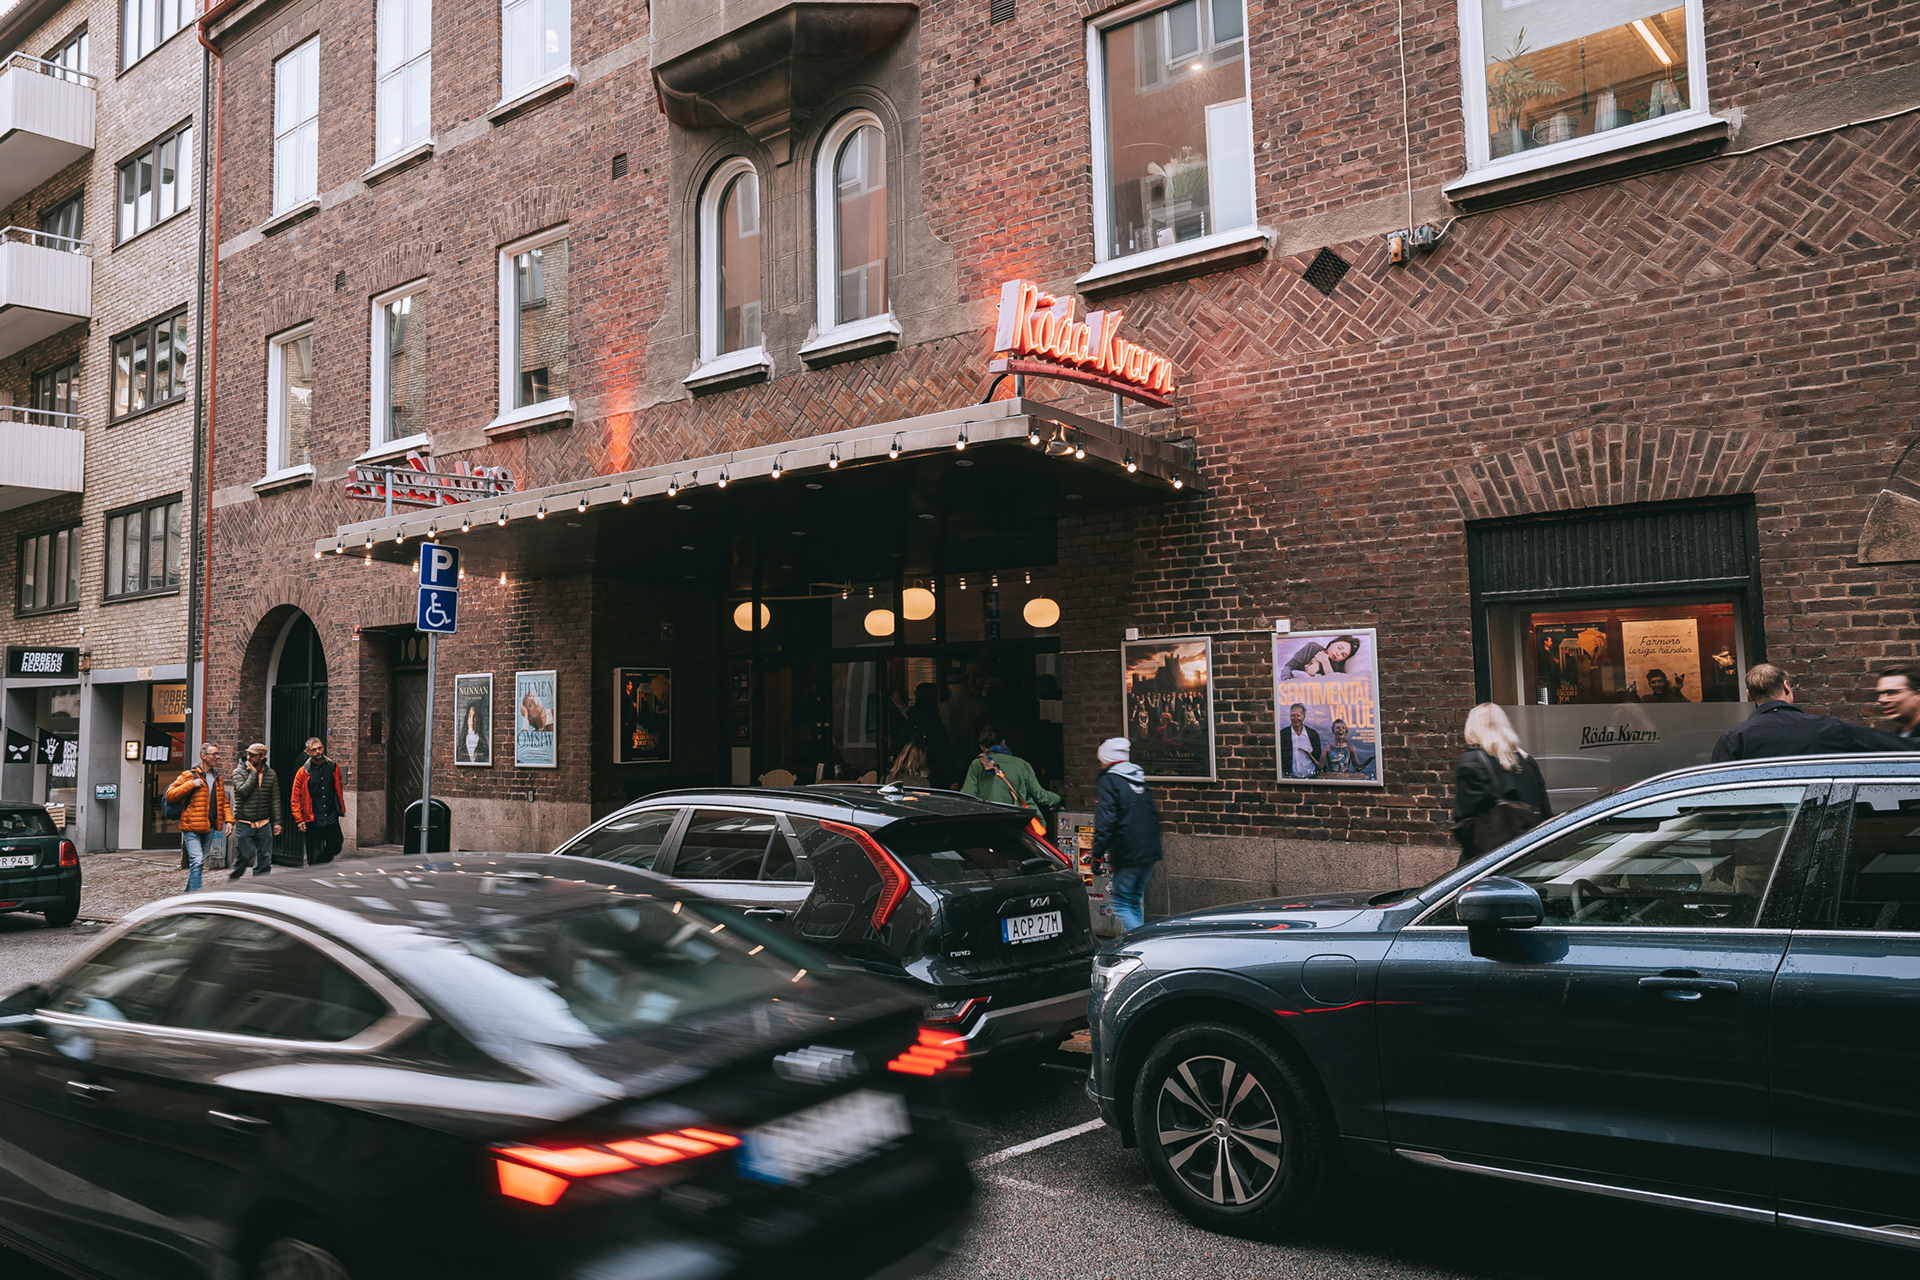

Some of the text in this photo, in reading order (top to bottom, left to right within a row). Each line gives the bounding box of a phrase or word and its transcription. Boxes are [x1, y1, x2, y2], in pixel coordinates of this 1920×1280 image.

[1004, 280, 1176, 394] Röda Kvarn
[431, 548, 453, 582] P
[1640, 636, 1681, 646] Farmors
[1658, 645, 1693, 655] händer
[23, 652, 64, 663] FOBBECK
[21, 662, 62, 672] RECORDS
[158, 689, 187, 702] FOBBE
[519, 681, 554, 697] FILMEN
[1278, 681, 1374, 706] SENTIMENTAL
[156, 703, 186, 715] RECOR
[1329, 704, 1375, 728] VALUE
[1581, 724, 1660, 745] Röda Kvarn
[10, 856, 30, 865] 943
[1030, 896, 1050, 908] KIA
[1012, 913, 1059, 938] ACP 27M
